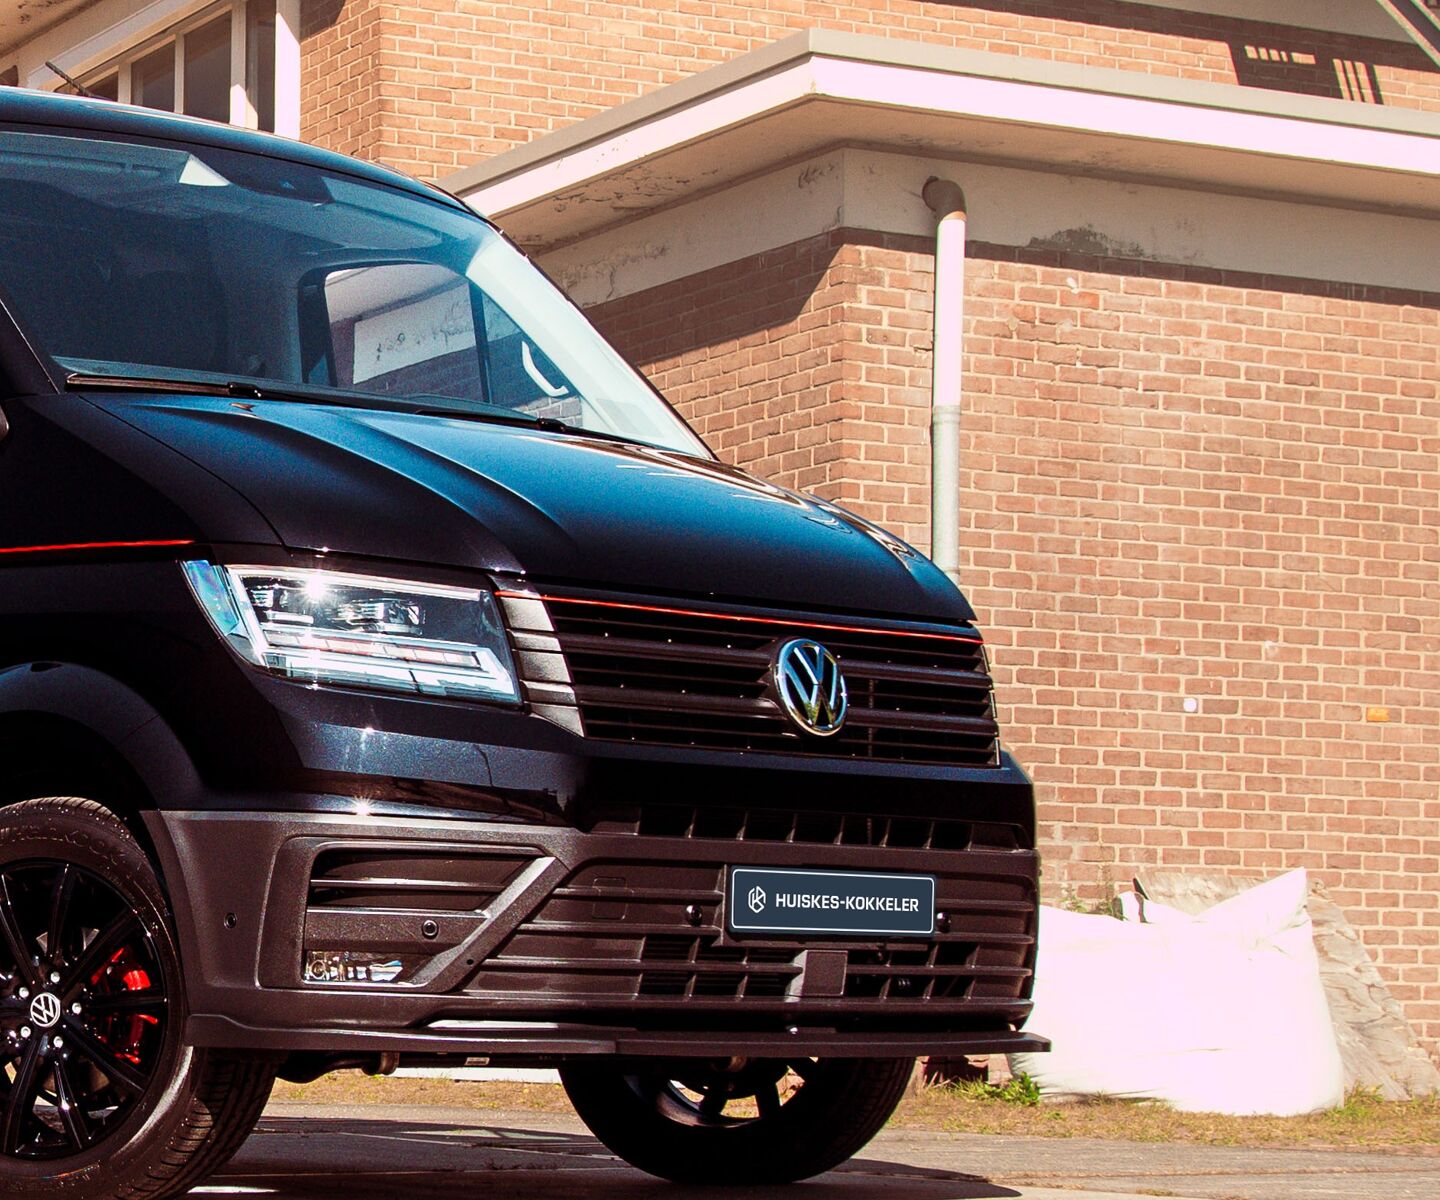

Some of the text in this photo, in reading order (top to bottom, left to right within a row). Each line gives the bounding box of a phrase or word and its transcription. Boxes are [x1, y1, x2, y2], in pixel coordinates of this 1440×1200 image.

[778, 640, 844, 733] VW
[775, 893, 919, 912] HUISKES-KOKKELER
[31, 993, 60, 1027] VW
